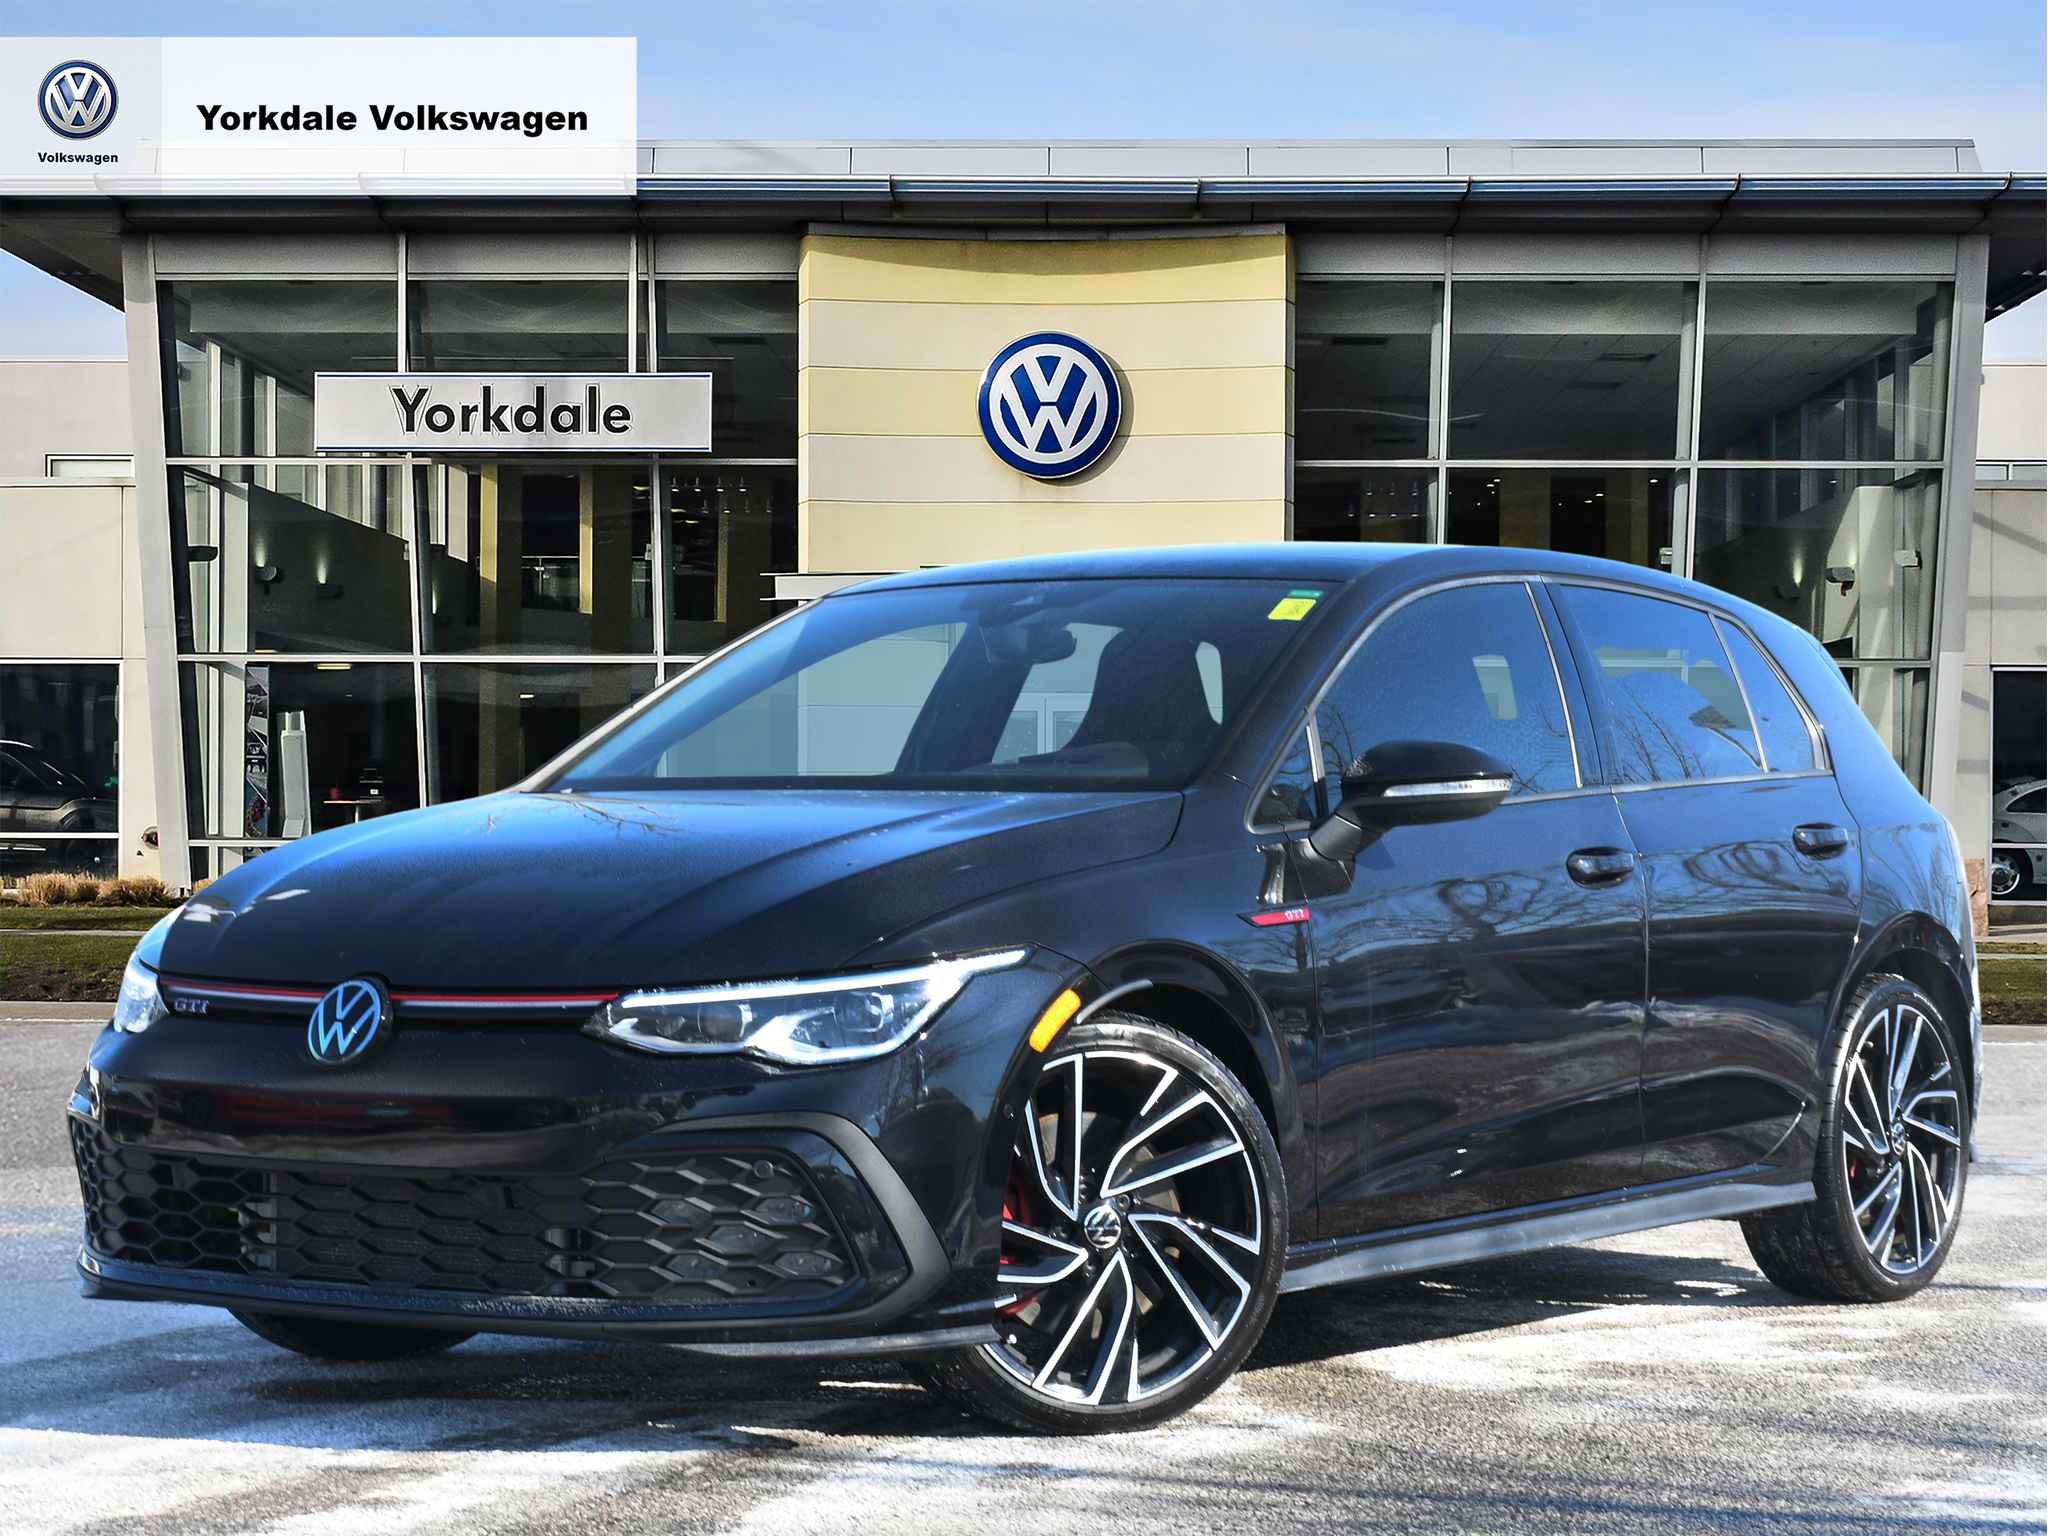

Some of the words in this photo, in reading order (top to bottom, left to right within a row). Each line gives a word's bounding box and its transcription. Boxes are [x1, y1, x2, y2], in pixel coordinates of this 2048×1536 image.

[390, 385, 632, 434] Yorkdale
[989, 343, 1109, 465] VW
[1284, 908, 1305, 921] GTI
[173, 997, 210, 1015] GTI
[308, 981, 381, 1063] VW
